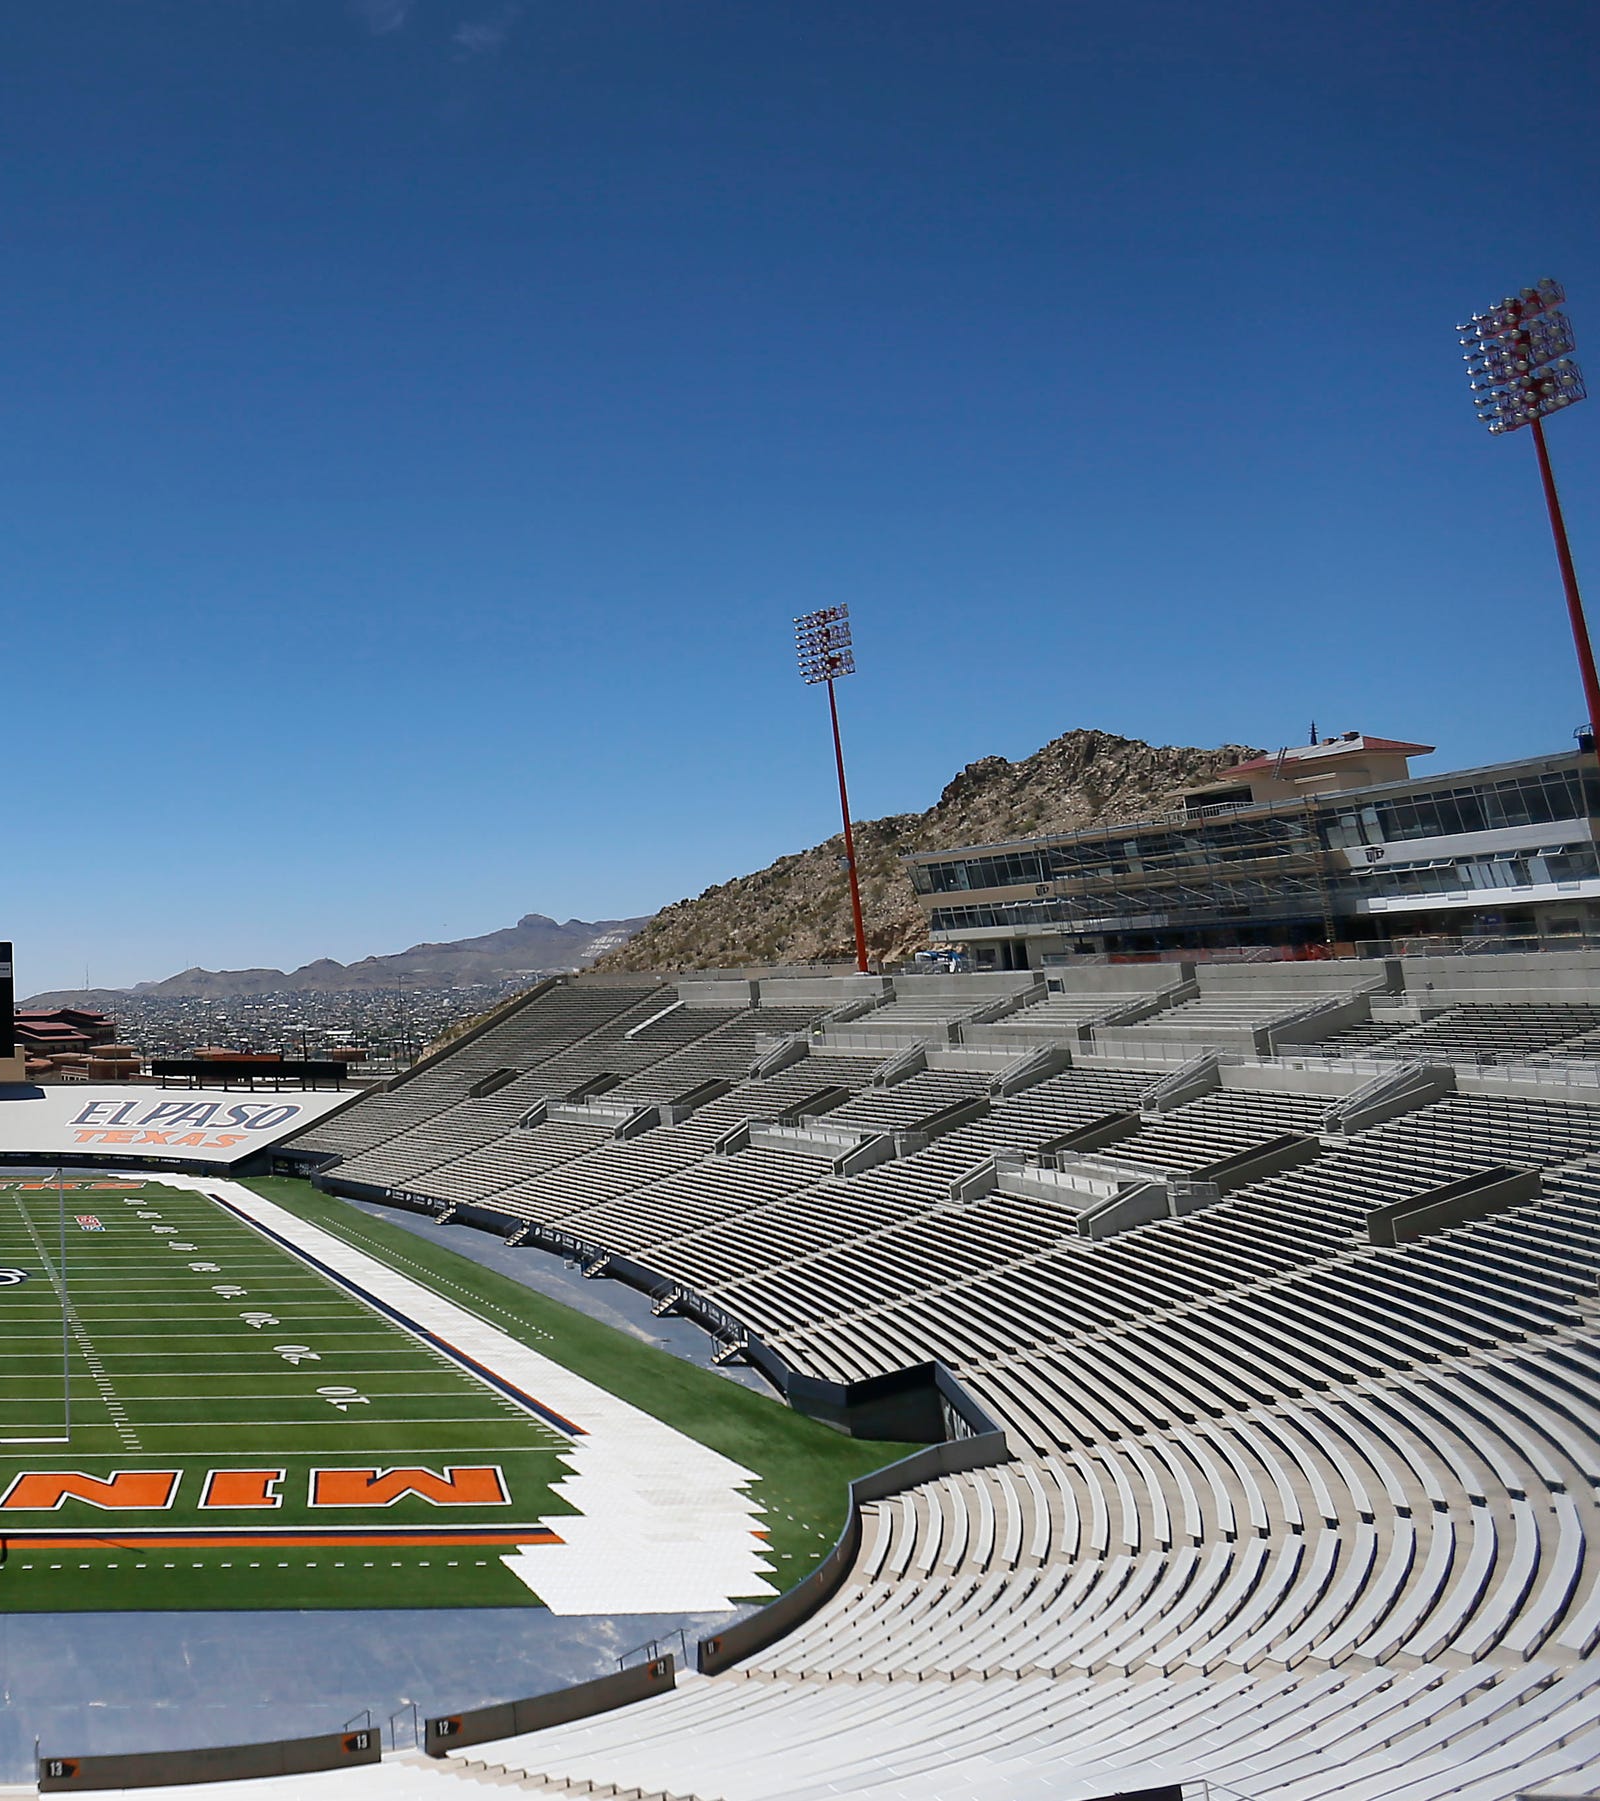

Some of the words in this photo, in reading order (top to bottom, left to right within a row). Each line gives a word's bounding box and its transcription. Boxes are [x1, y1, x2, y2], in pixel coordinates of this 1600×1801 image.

[65, 1099, 140, 1127] EL
[136, 1100, 303, 1131] PASO
[74, 1129, 250, 1148] TEXAS
[273, 1344, 322, 1362] 20
[316, 1386, 371, 1404] 10
[438, 1720, 450, 1736] 12
[356, 1733, 368, 1750] 13
[50, 1760, 63, 1776] 13
